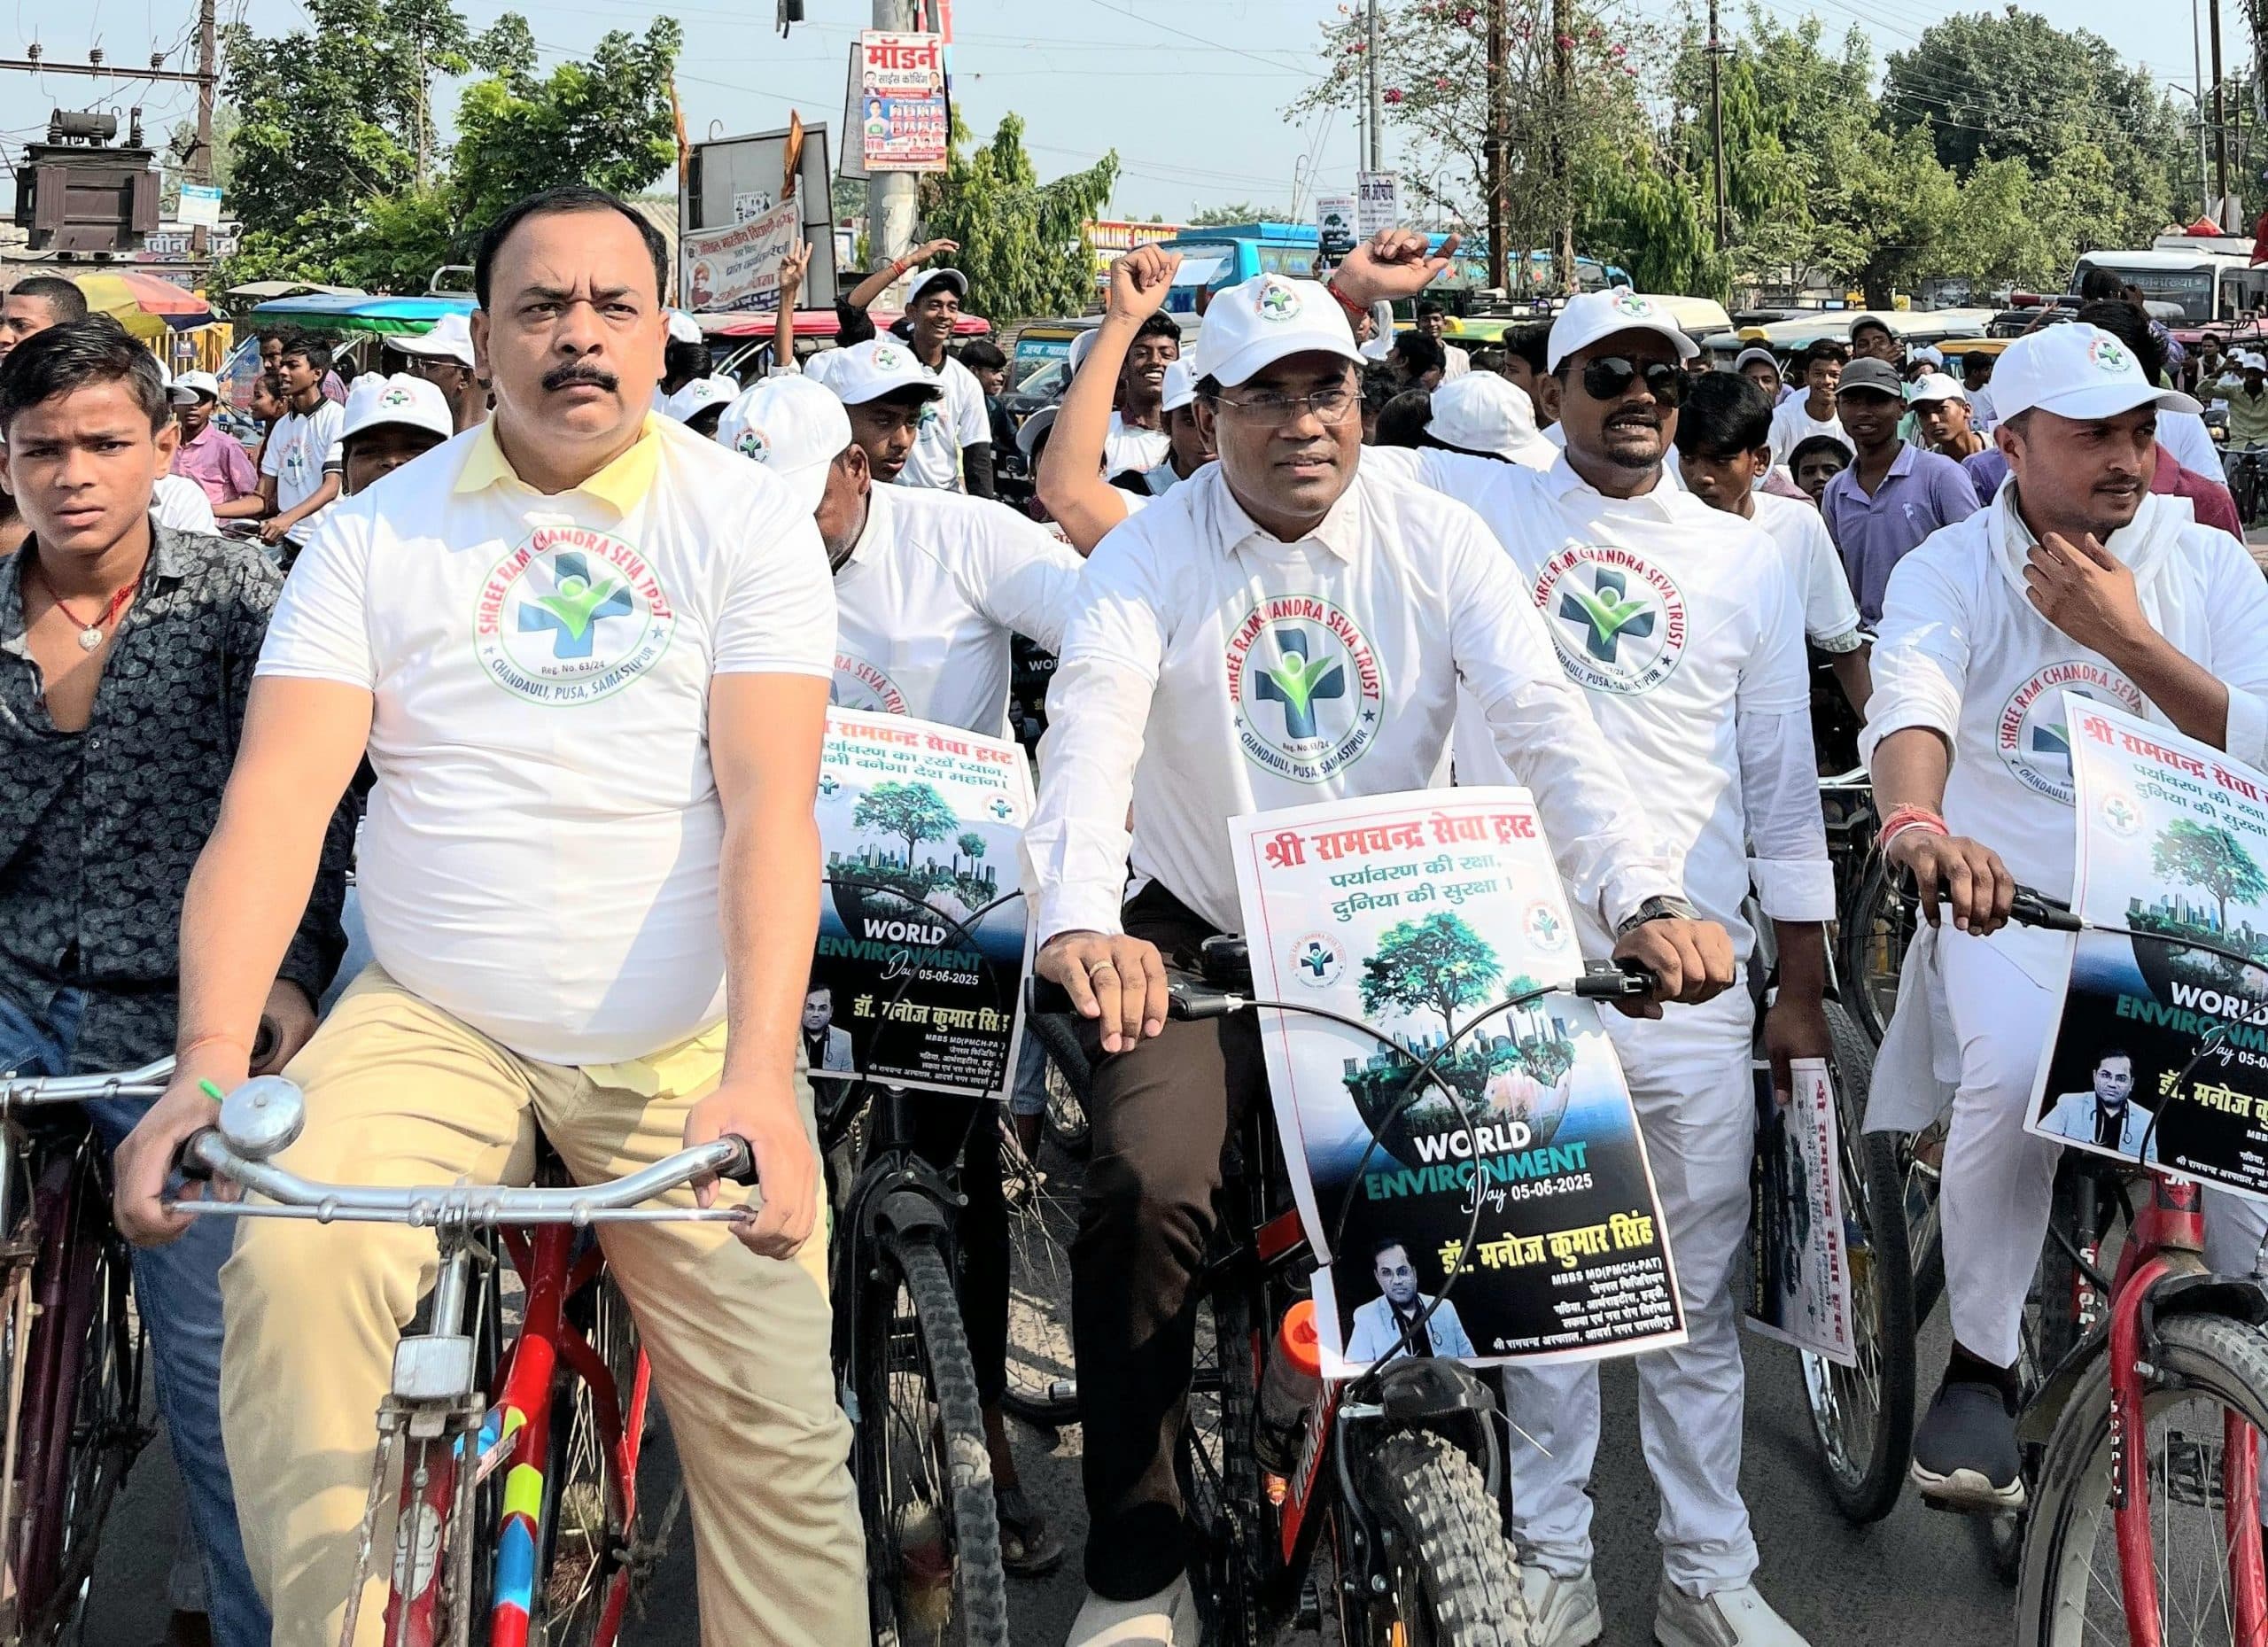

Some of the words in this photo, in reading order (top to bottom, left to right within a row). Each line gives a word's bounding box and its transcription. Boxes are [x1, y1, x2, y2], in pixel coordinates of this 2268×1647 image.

[865, 38, 938, 69] मॉडर्न
[1088, 225, 1131, 249] ONLINE
[479, 581, 506, 635] SHREE
[496, 547, 532, 581] RAM
[532, 530, 610, 556] CHANDRA
[610, 545, 646, 583] SEVA
[1645, 569, 1675, 600] SEVA
[1667, 602, 1685, 649] TRUST
[541, 666, 559, 676] Reg.
[1326, 610, 1360, 648] SEVA
[1355, 647, 1379, 701] TRUST
[492, 658, 550, 701] CHANDAULI,
[555, 683, 588, 700] PUSA,
[854, 663, 888, 693] SEVA
[1587, 672, 1613, 689] PUSA,
[2001, 706, 2023, 750] SHREE
[2015, 680, 2044, 709] RAM
[2043, 664, 2109, 687] CHANDRA
[925, 733, 969, 757] सेवा
[1241, 732, 1291, 774] CHANDAULI,
[1293, 764, 1320, 779] PUSA,
[2084, 717, 2115, 745] श्री
[2118, 731, 2208, 781] रामचन्द्र
[2210, 763, 2260, 802] सेवा
[913, 765, 944, 781] देश
[2133, 763, 2202, 796] पर्यावरण
[2207, 789, 2232, 807] की
[2133, 781, 2187, 808] दुनिया
[2193, 800, 2218, 818] की
[1265, 832, 1306, 869] श्री
[1310, 821, 1425, 860] रामचन्द्र
[1428, 811, 1489, 844] सेवा
[1330, 864, 1418, 888] पर्यावरण
[1423, 854, 1454, 874] की
[1331, 892, 1400, 923] दुनिया
[1404, 882, 1436, 903] की
[863, 918, 947, 945] WORLD
[818, 935, 983, 972] ENVIRONMENT
[919, 969, 980, 986] 05-06-2025
[854, 993, 875, 1018] डॉ.
[932, 1006, 977, 1033] कुमार
[925, 1033, 948, 1043] MBBS
[2159, 1069, 2186, 1101] डॉ.
[2193, 1080, 2253, 1118] मनोज
[1413, 1121, 1533, 1163] WORLD
[1364, 1140, 1588, 1201] ENVIRONMENT
[1461, 1165, 1507, 1214] Day
[1511, 1173, 1593, 1200] 05-06-2025
[1438, 1239, 1474, 1275] डॉ.
[1477, 1231, 1546, 1269] मनोज
[1547, 1224, 1611, 1269] कुमार
[1608, 1208, 1654, 1250] सिंह
[1551, 1270, 1584, 1286] MBBS
[1585, 1256, 1663, 1280] MD(PMCH-PAT)
